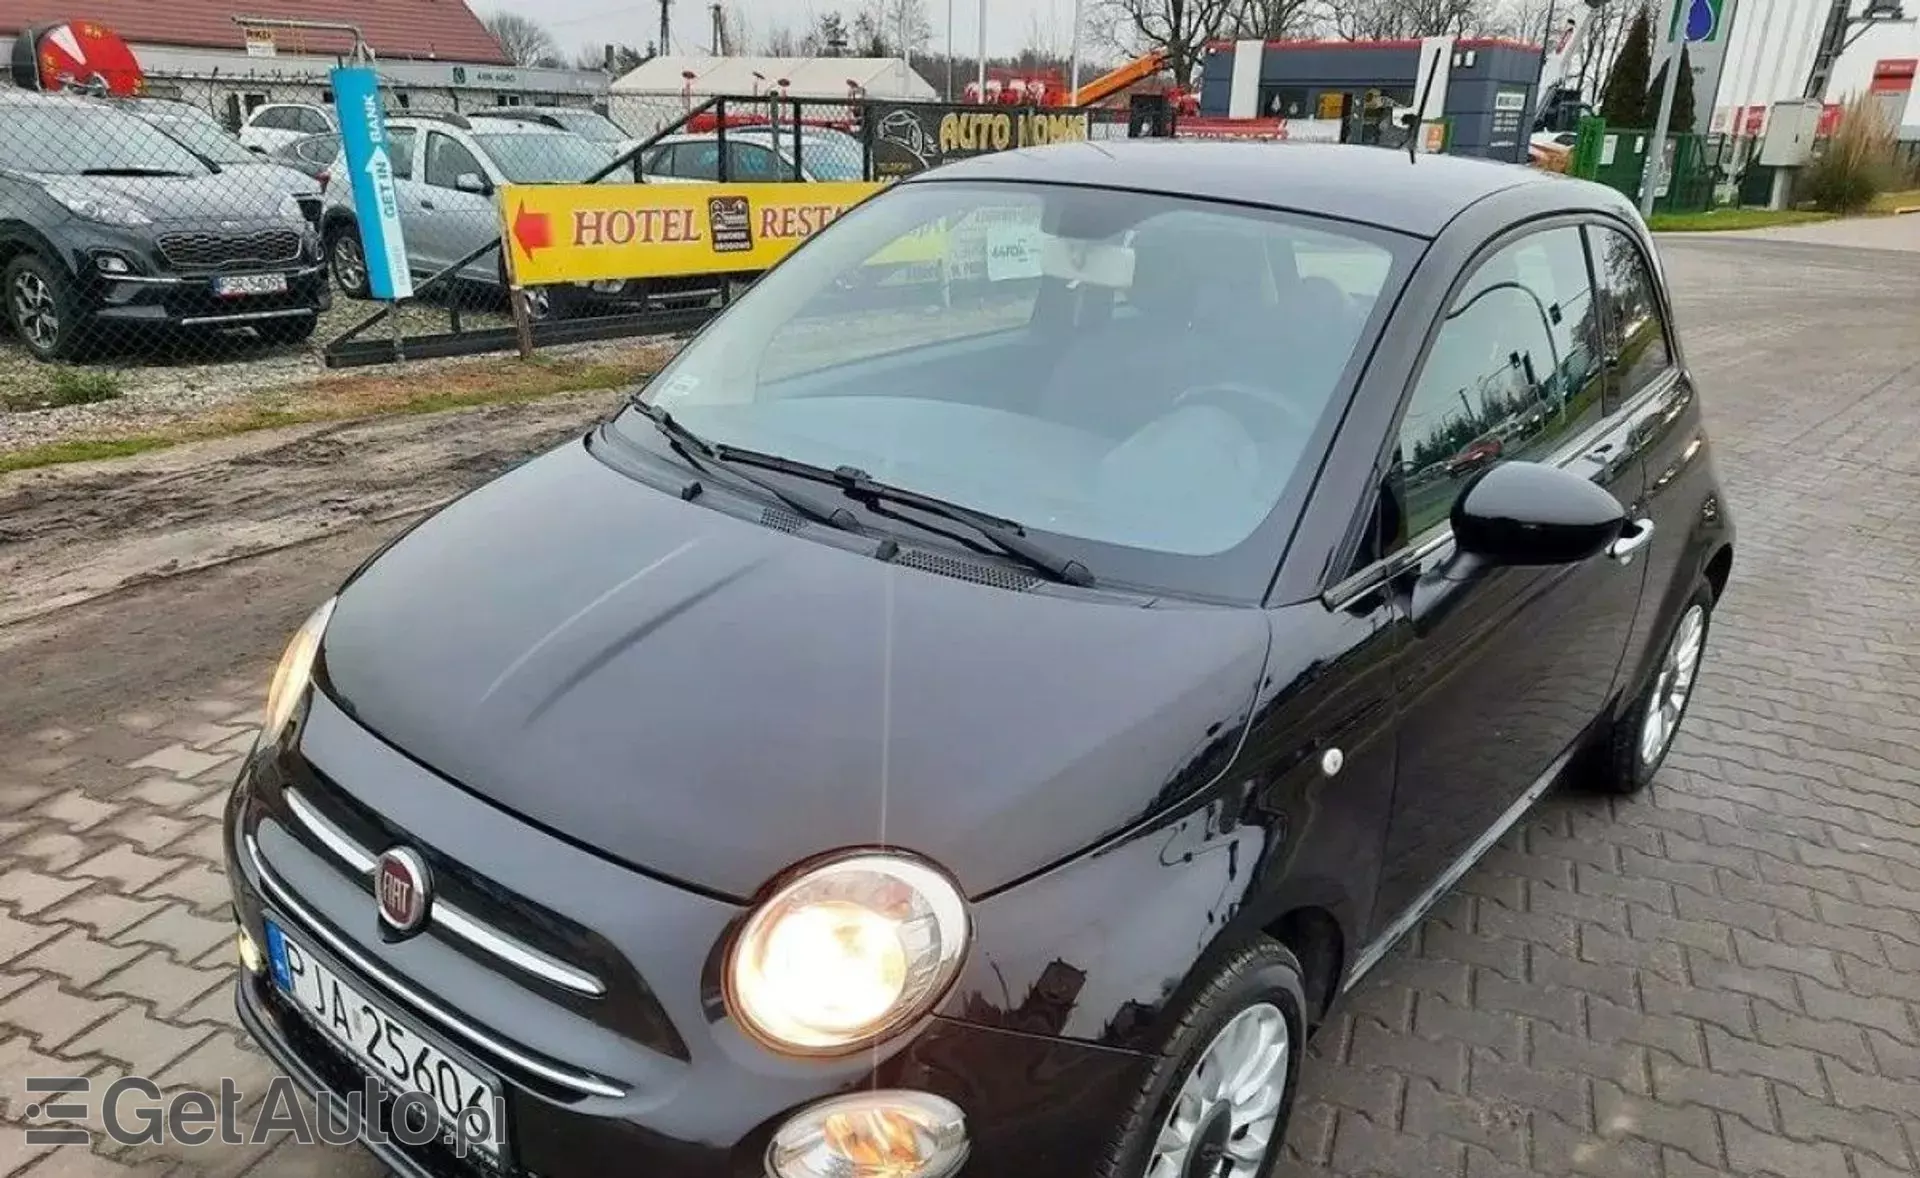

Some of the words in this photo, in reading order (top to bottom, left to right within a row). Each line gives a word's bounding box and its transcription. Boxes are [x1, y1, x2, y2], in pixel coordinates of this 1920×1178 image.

[363, 94, 383, 143] BANK
[940, 112, 1010, 152] AUTO
[380, 186, 395, 218] GET
[574, 209, 702, 246] HOTEL
[384, 870, 411, 914] FIAT
[285, 939, 353, 1042] PJA
[361, 1004, 486, 1135] 25606
